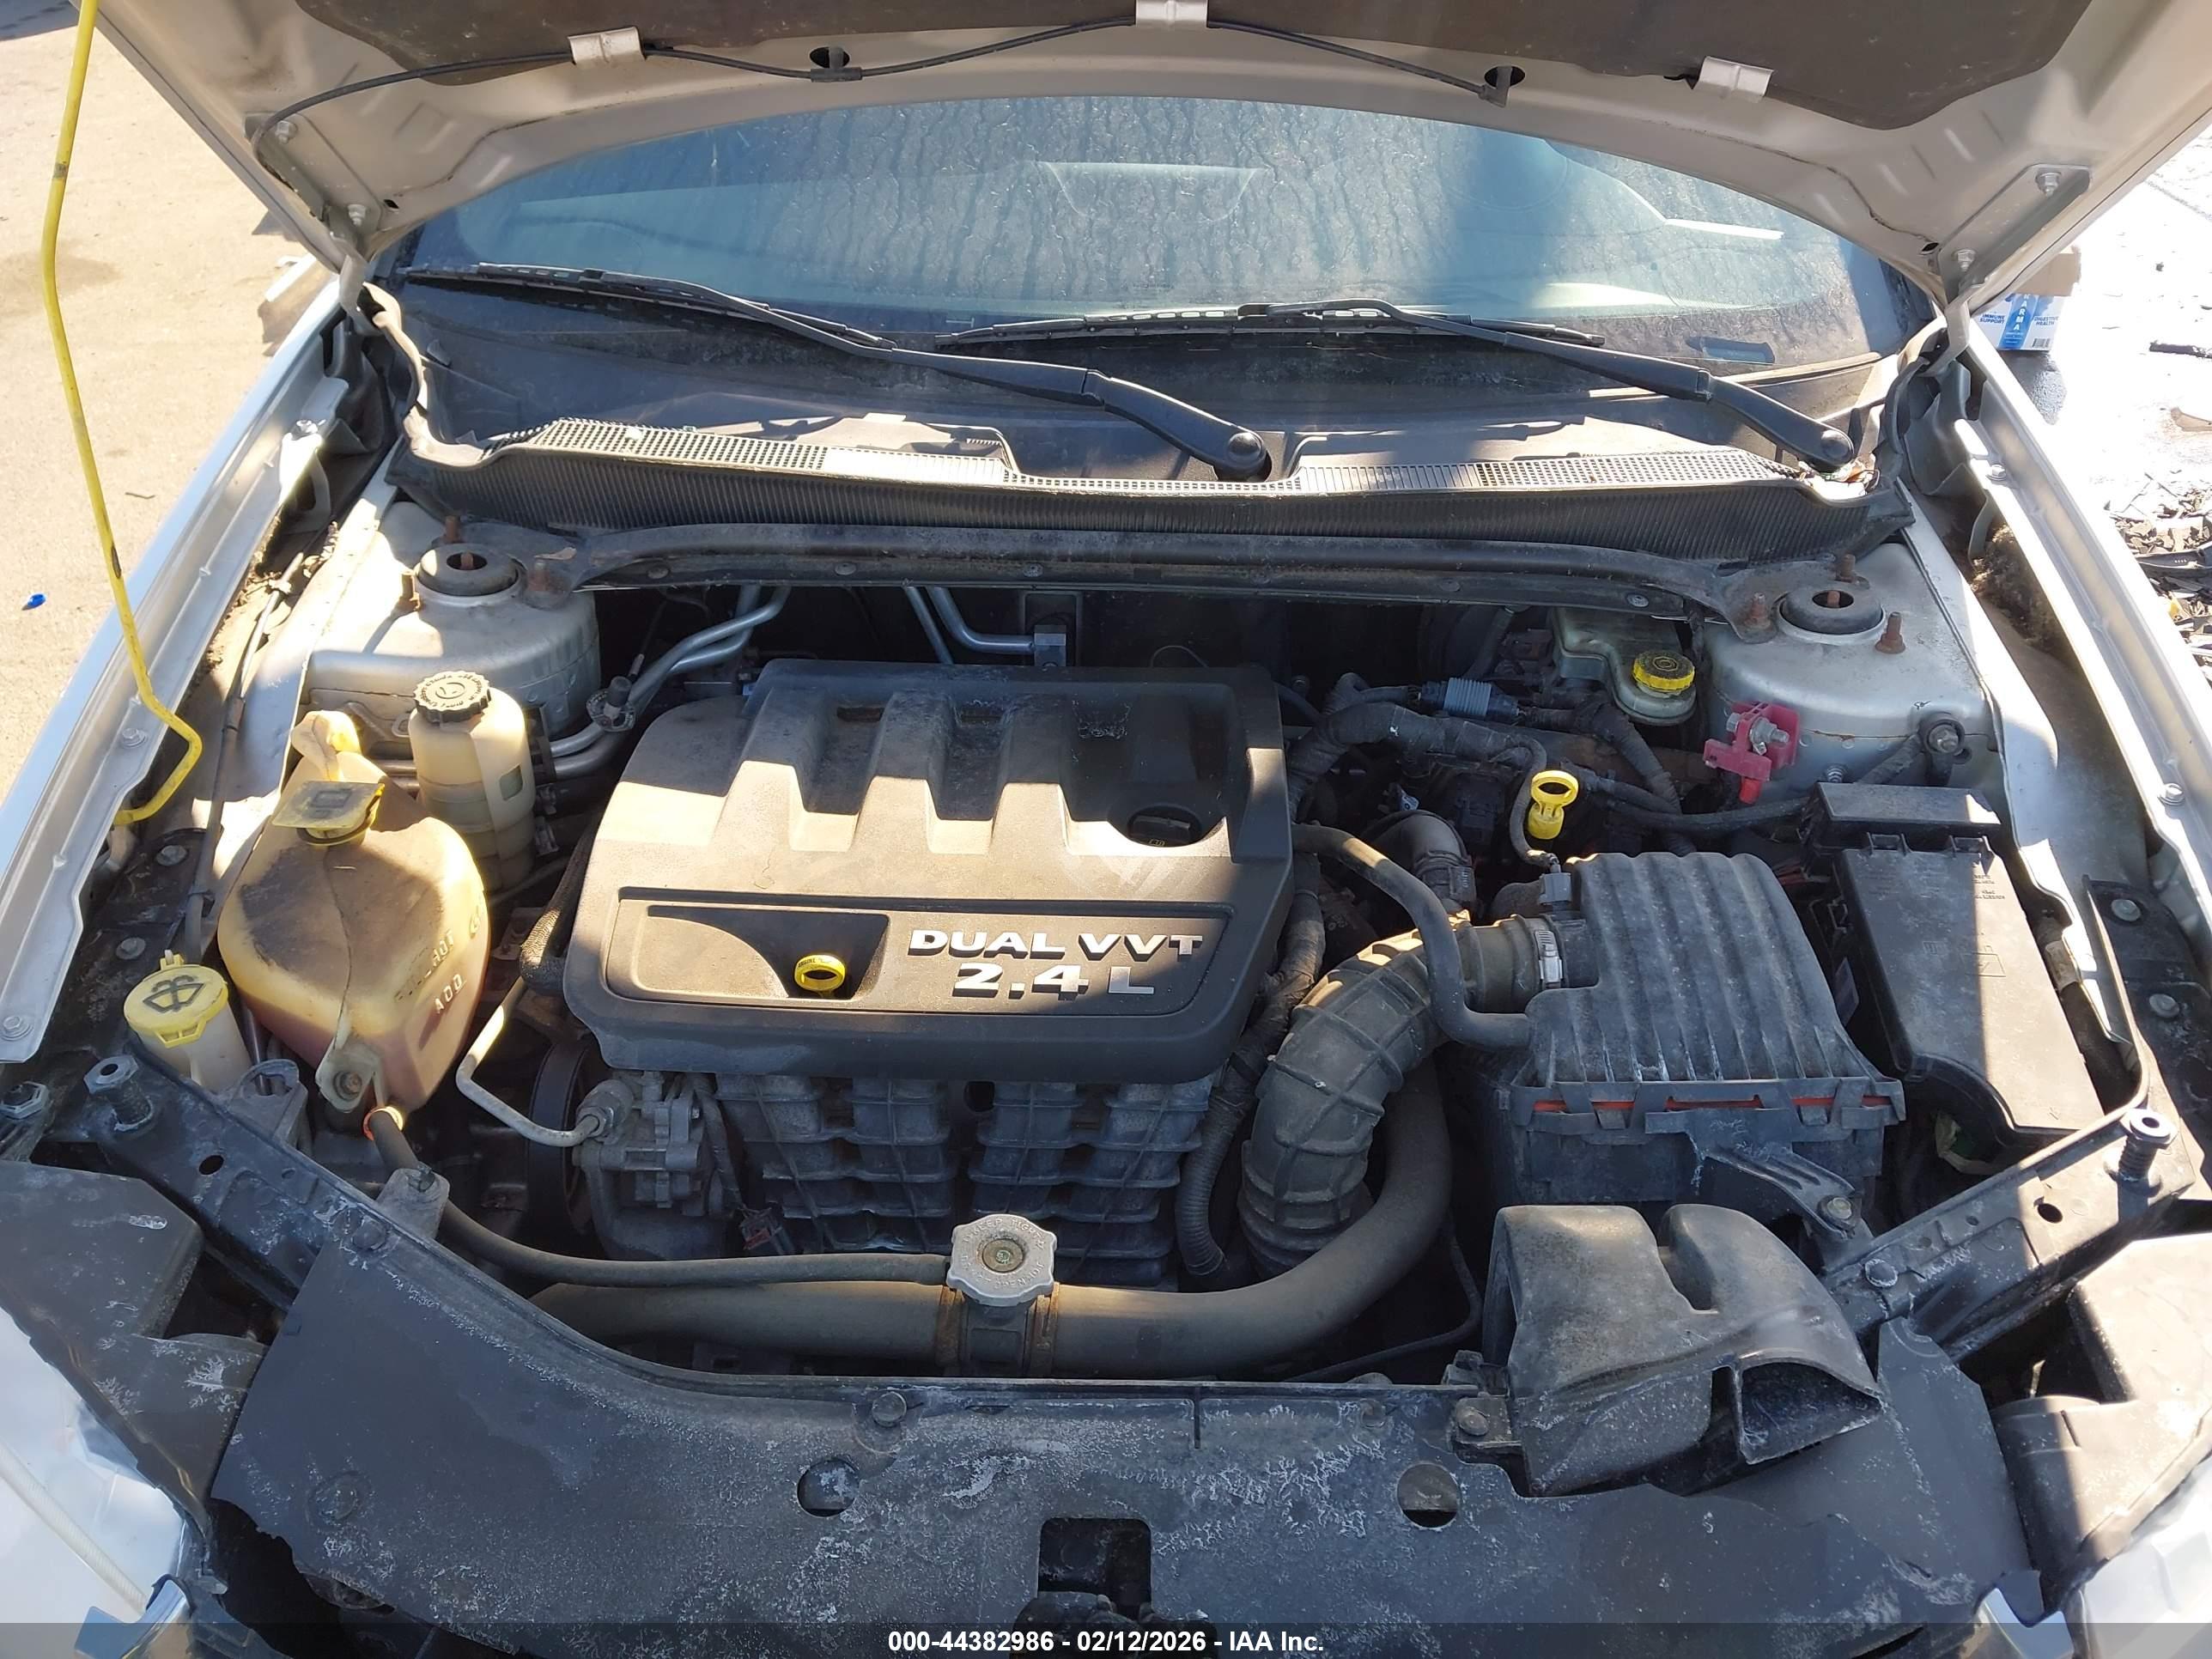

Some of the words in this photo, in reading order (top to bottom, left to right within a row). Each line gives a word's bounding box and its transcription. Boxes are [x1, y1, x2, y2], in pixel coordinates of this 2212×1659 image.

[908, 930, 1066, 960] DUAL
[1079, 934, 1203, 962] VVT
[434, 973, 464, 1014] ADD
